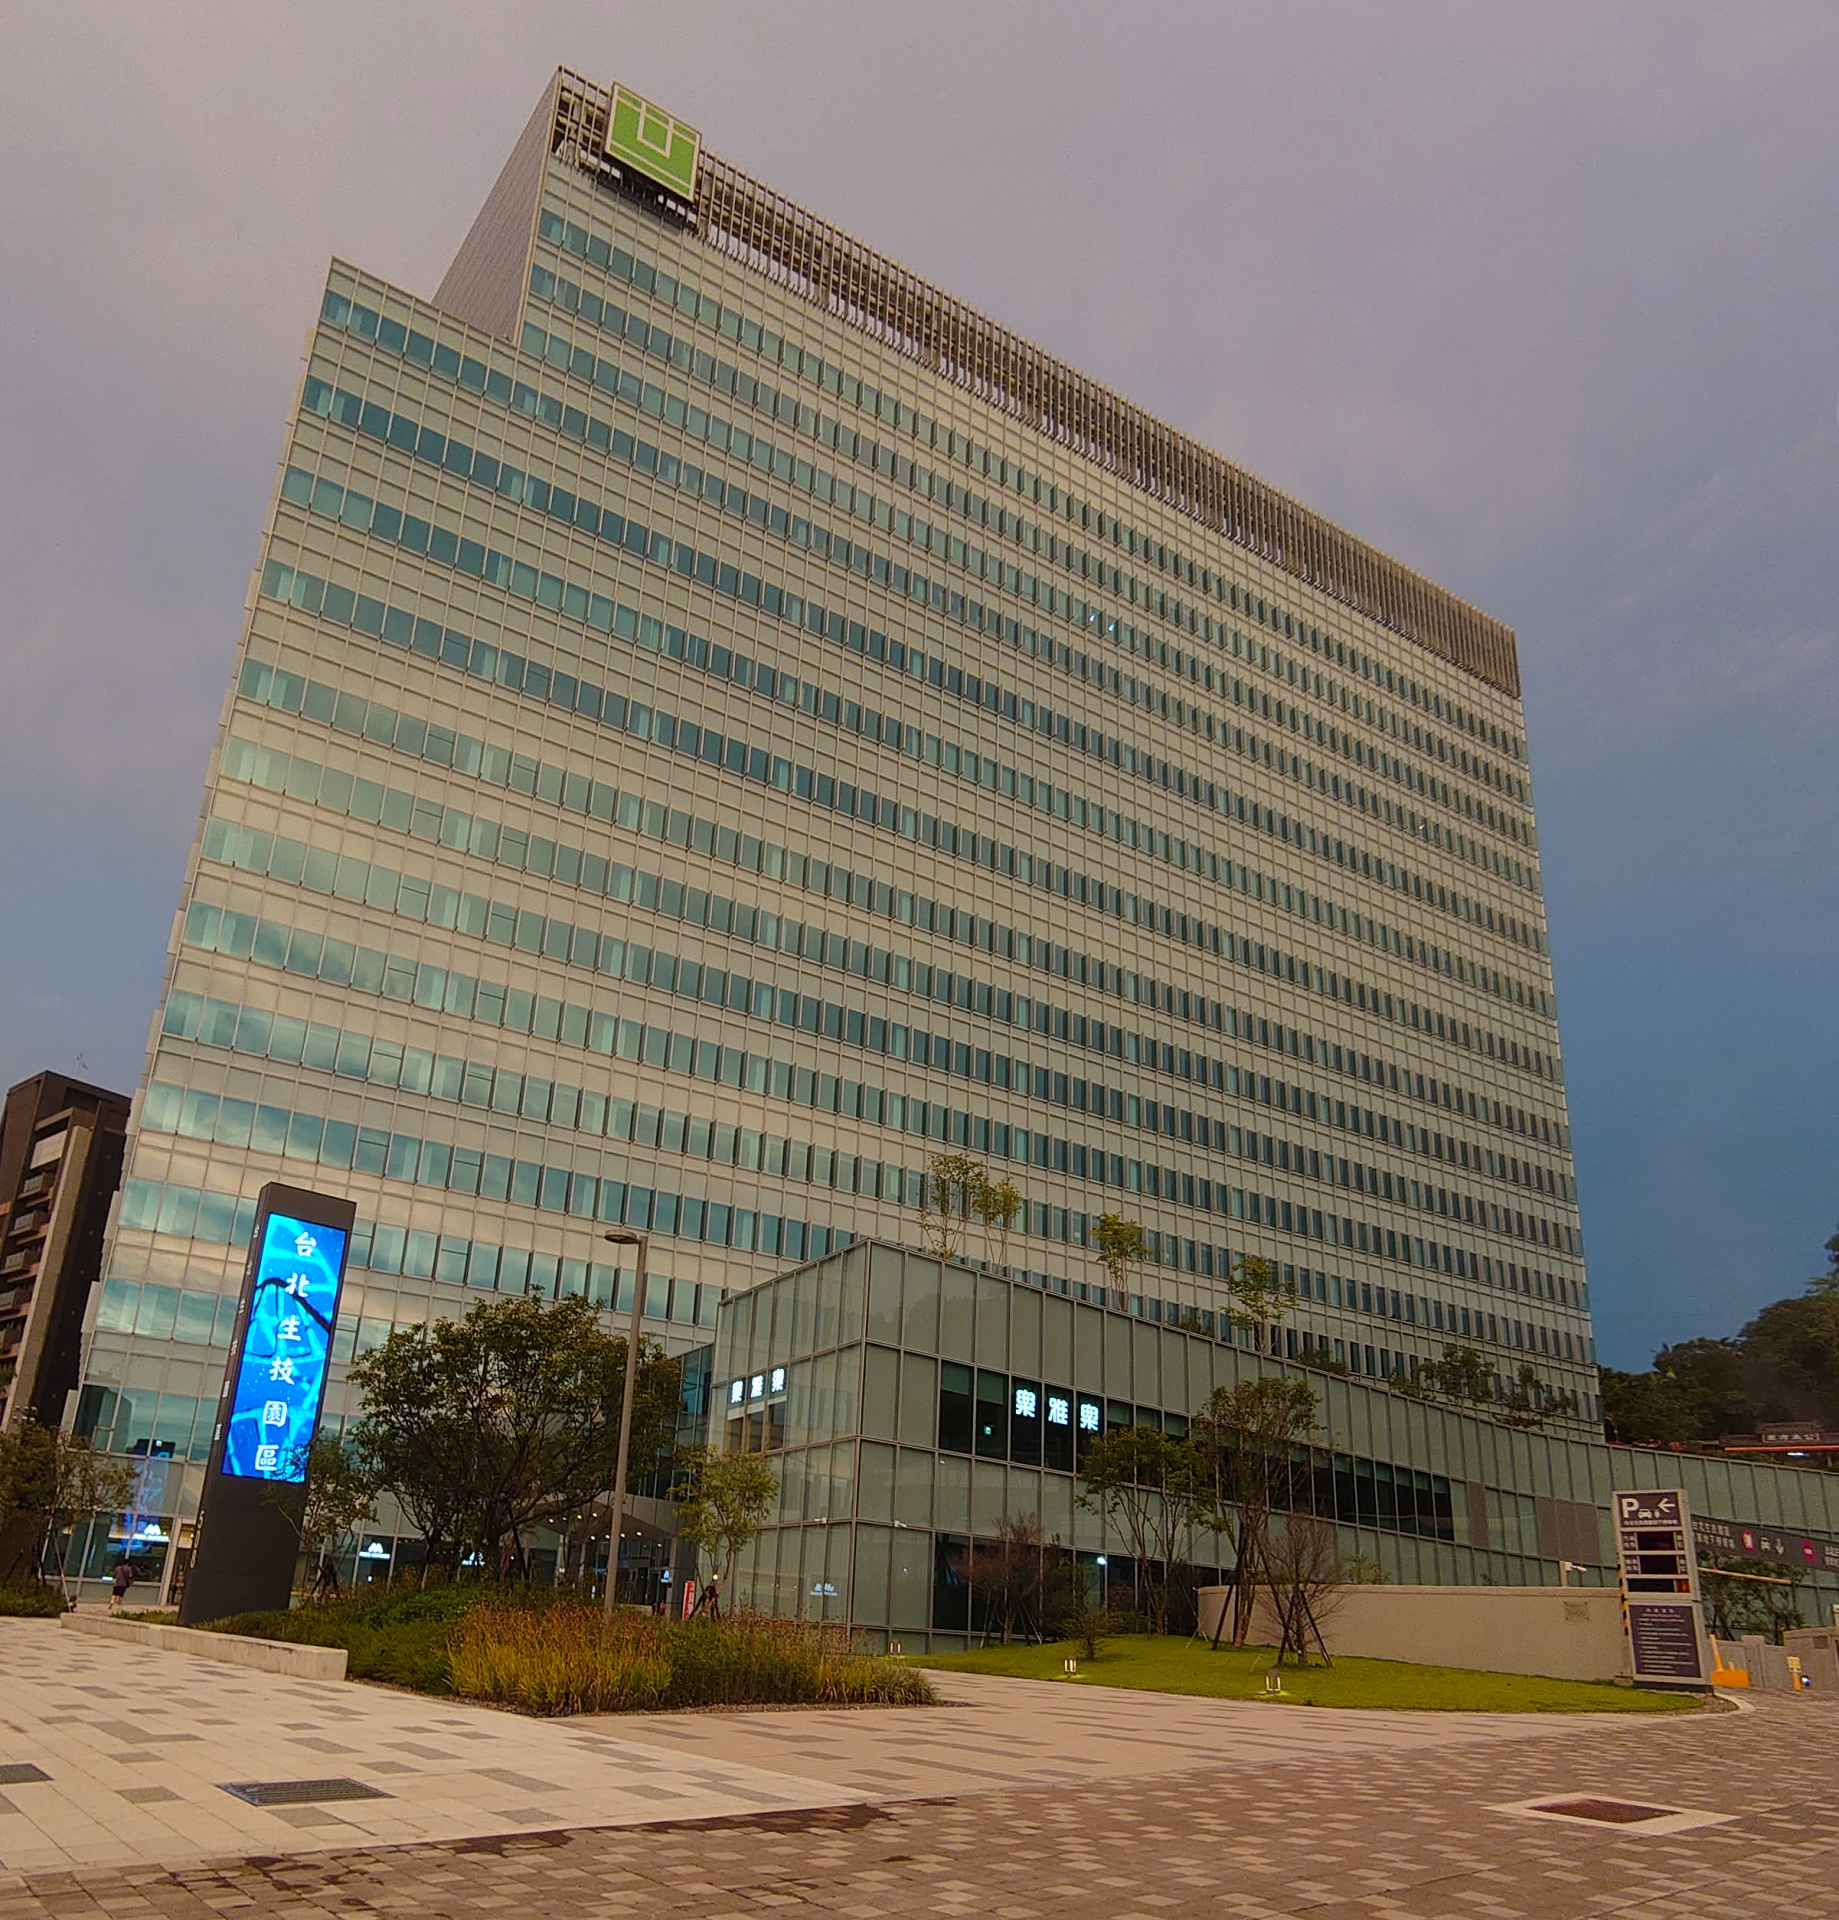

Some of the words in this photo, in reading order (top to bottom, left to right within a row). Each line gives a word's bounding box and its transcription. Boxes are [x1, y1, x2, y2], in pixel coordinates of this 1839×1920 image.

[255, 1232, 317, 1471] 台北生技園區
[1015, 1388, 1099, 1431] 樂雅樂
[1621, 1497, 1640, 1519] P
